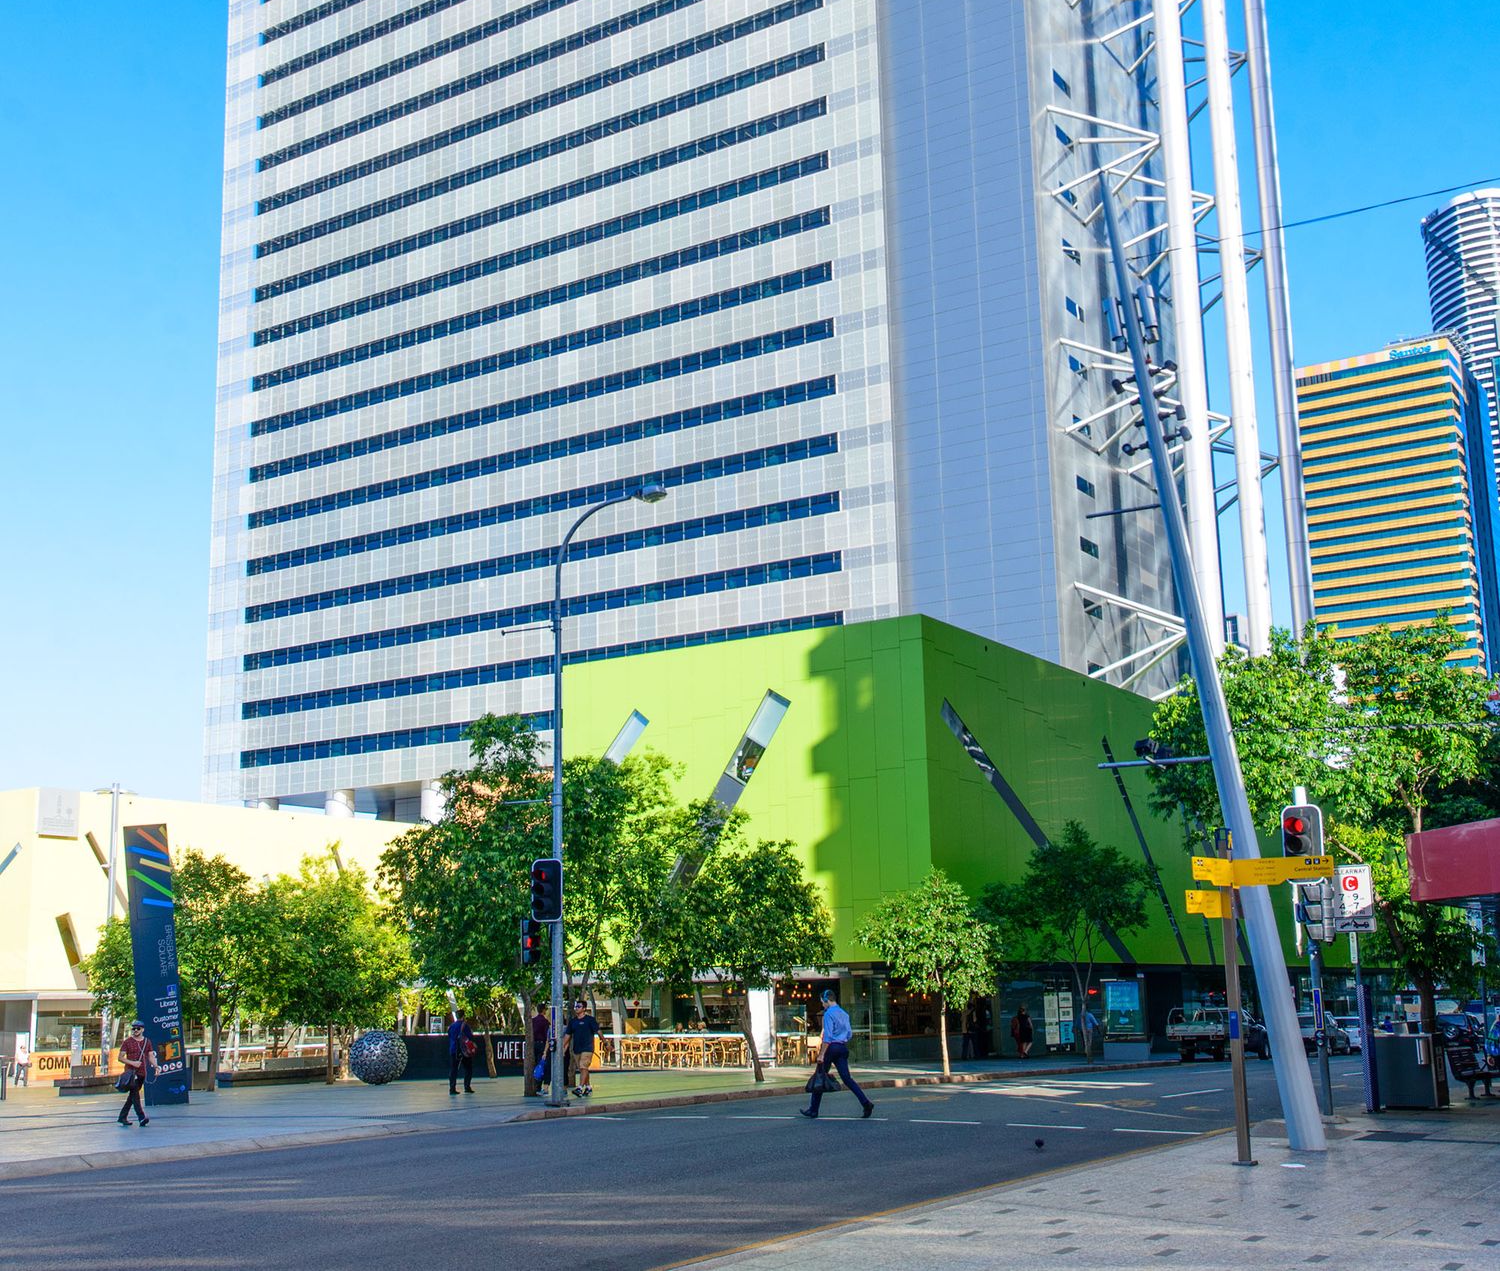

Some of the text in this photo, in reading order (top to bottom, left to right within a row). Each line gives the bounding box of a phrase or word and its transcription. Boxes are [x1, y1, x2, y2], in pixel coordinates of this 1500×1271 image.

[1389, 345, 1431, 360] Santos
[1345, 876, 1357, 891] C
[1352, 893, 1359, 901] 9
[1353, 901, 1359, 909] 7
[164, 924, 175, 970] BRISBANE
[158, 939, 168, 977] SQUARE
[160, 1000, 178, 1008] Library
[167, 1006, 178, 1014] and
[153, 1013, 179, 1024] Customer
[161, 1021, 180, 1029] Centre
[497, 1041, 520, 1060] CAFE
[38, 1054, 102, 1070] COMMNAL
